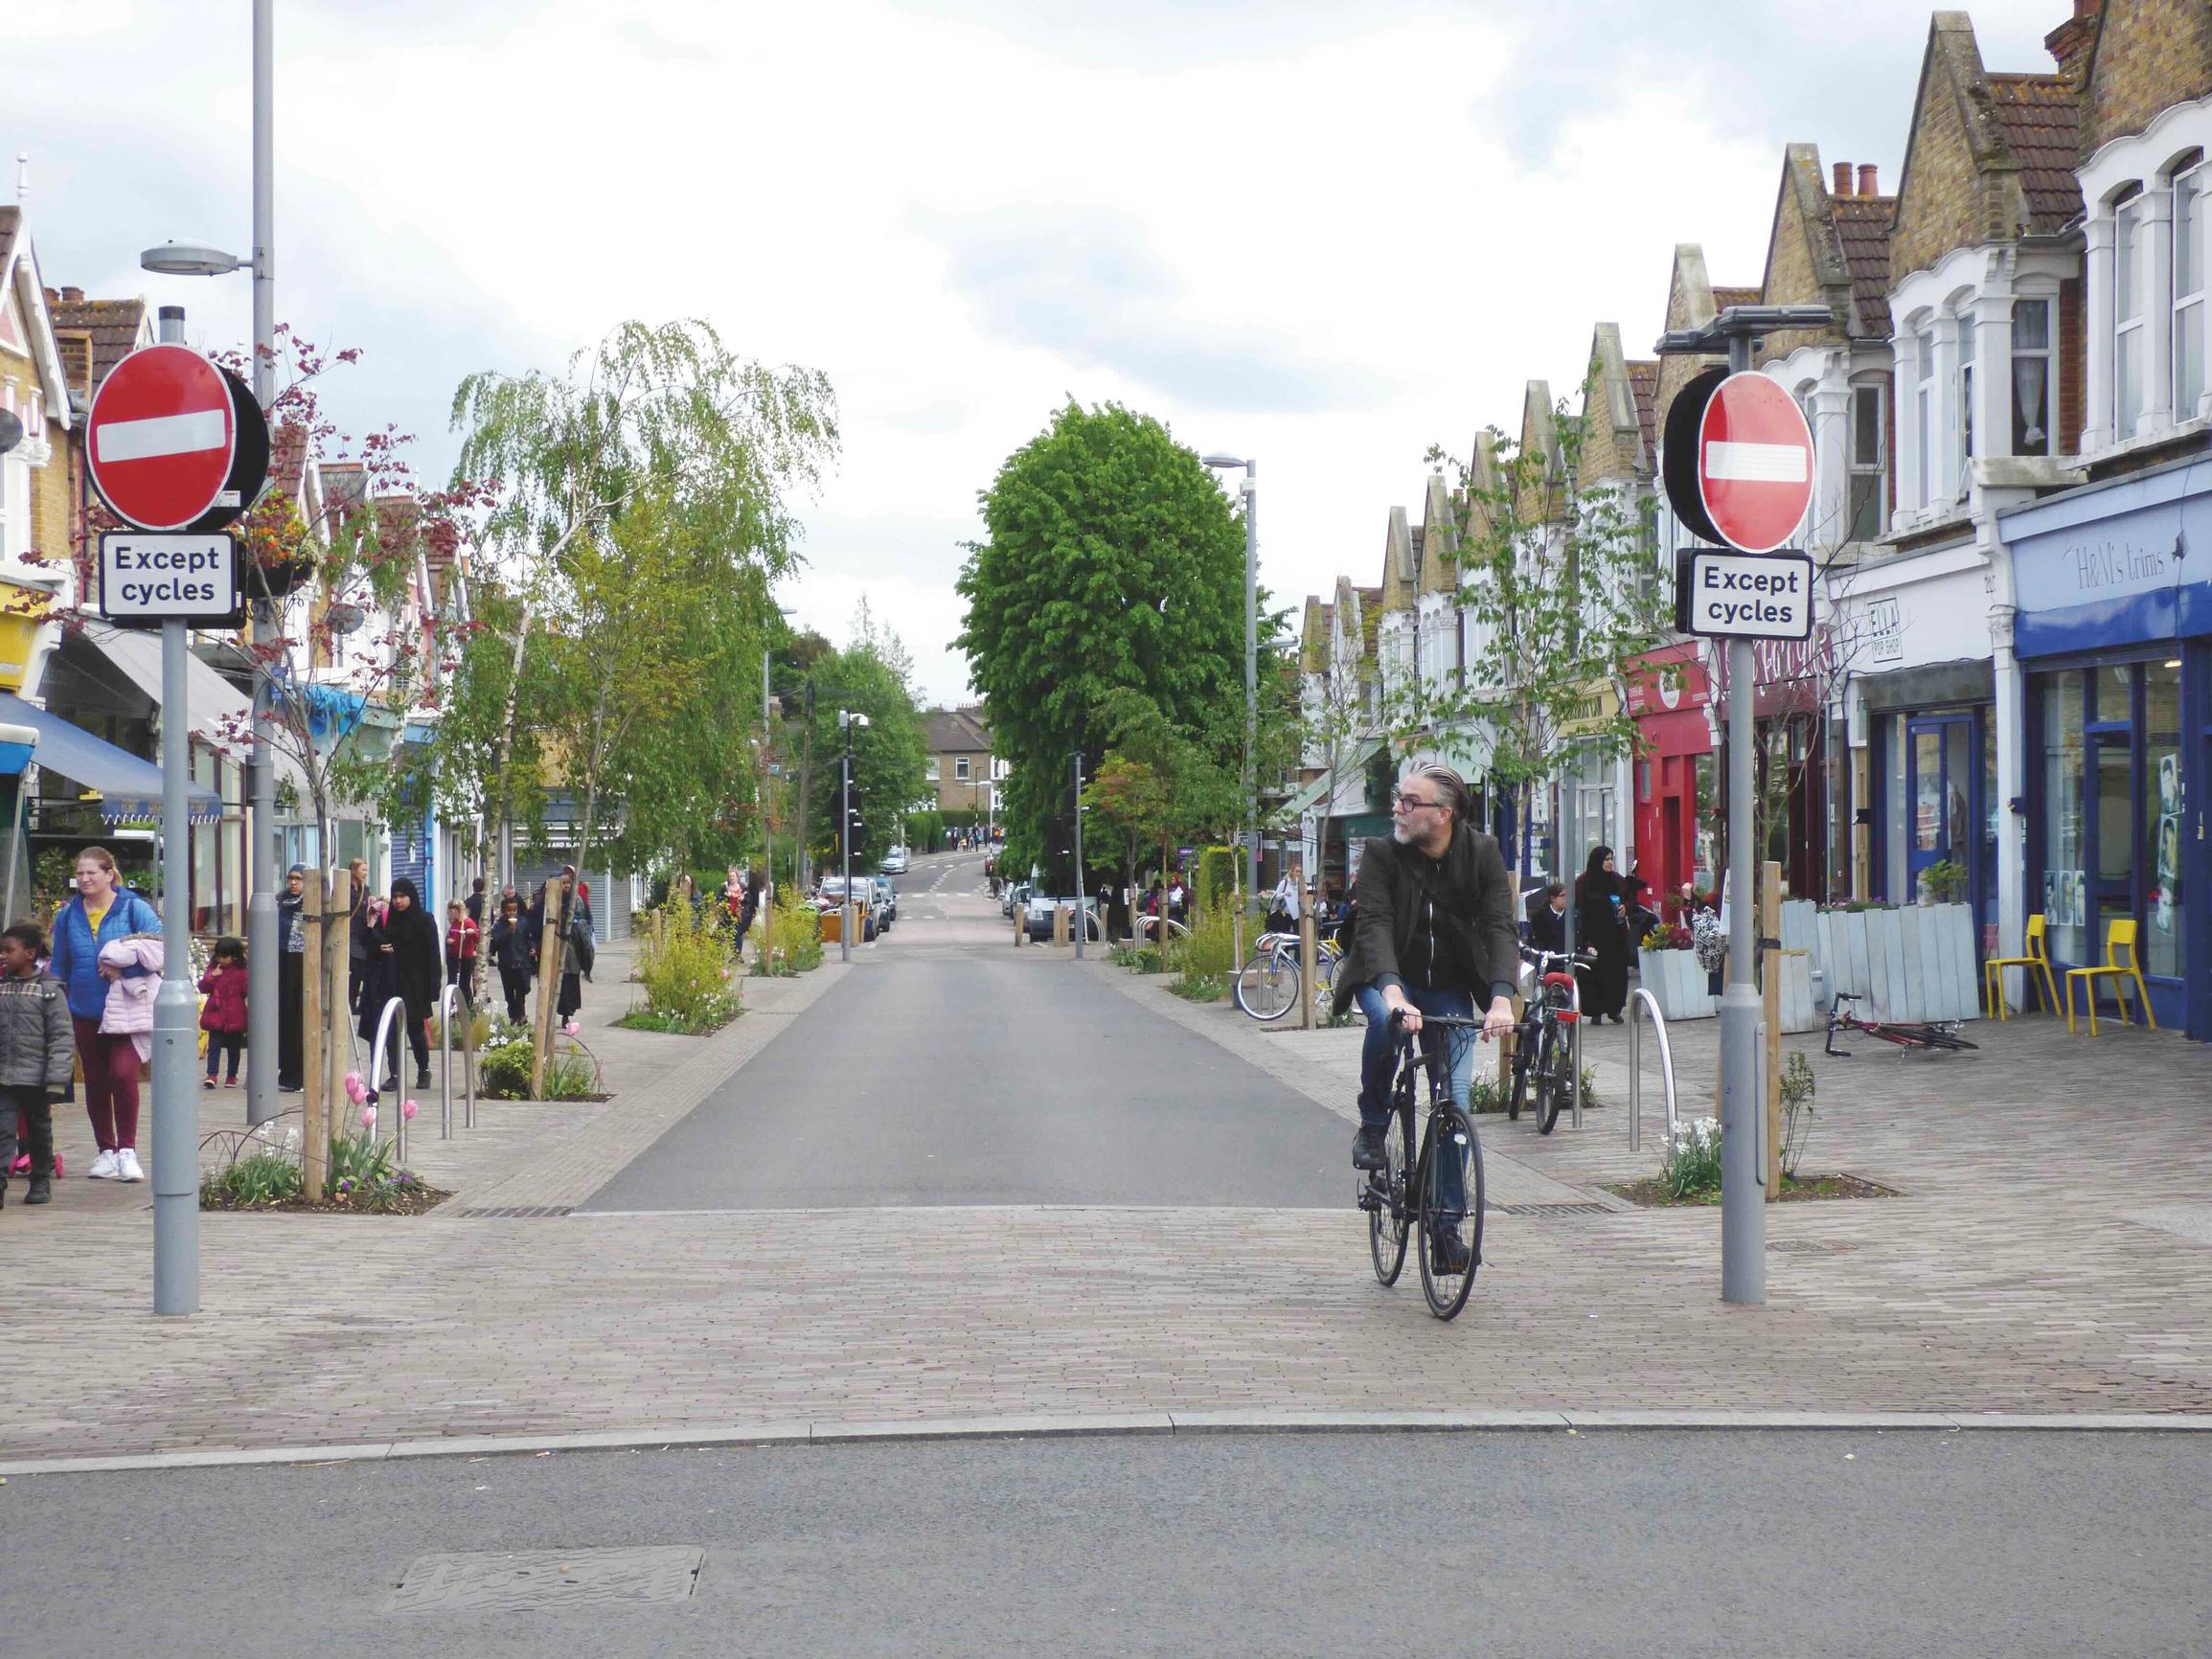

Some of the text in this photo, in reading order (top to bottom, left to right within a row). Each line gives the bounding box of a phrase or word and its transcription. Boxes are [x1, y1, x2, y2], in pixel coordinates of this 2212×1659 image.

[115, 546, 219, 574] Except
[2126, 542, 2165, 581] trims
[122, 578, 215, 605] cycles
[1704, 565, 1798, 596] Except
[1708, 599, 1792, 625] cycles
